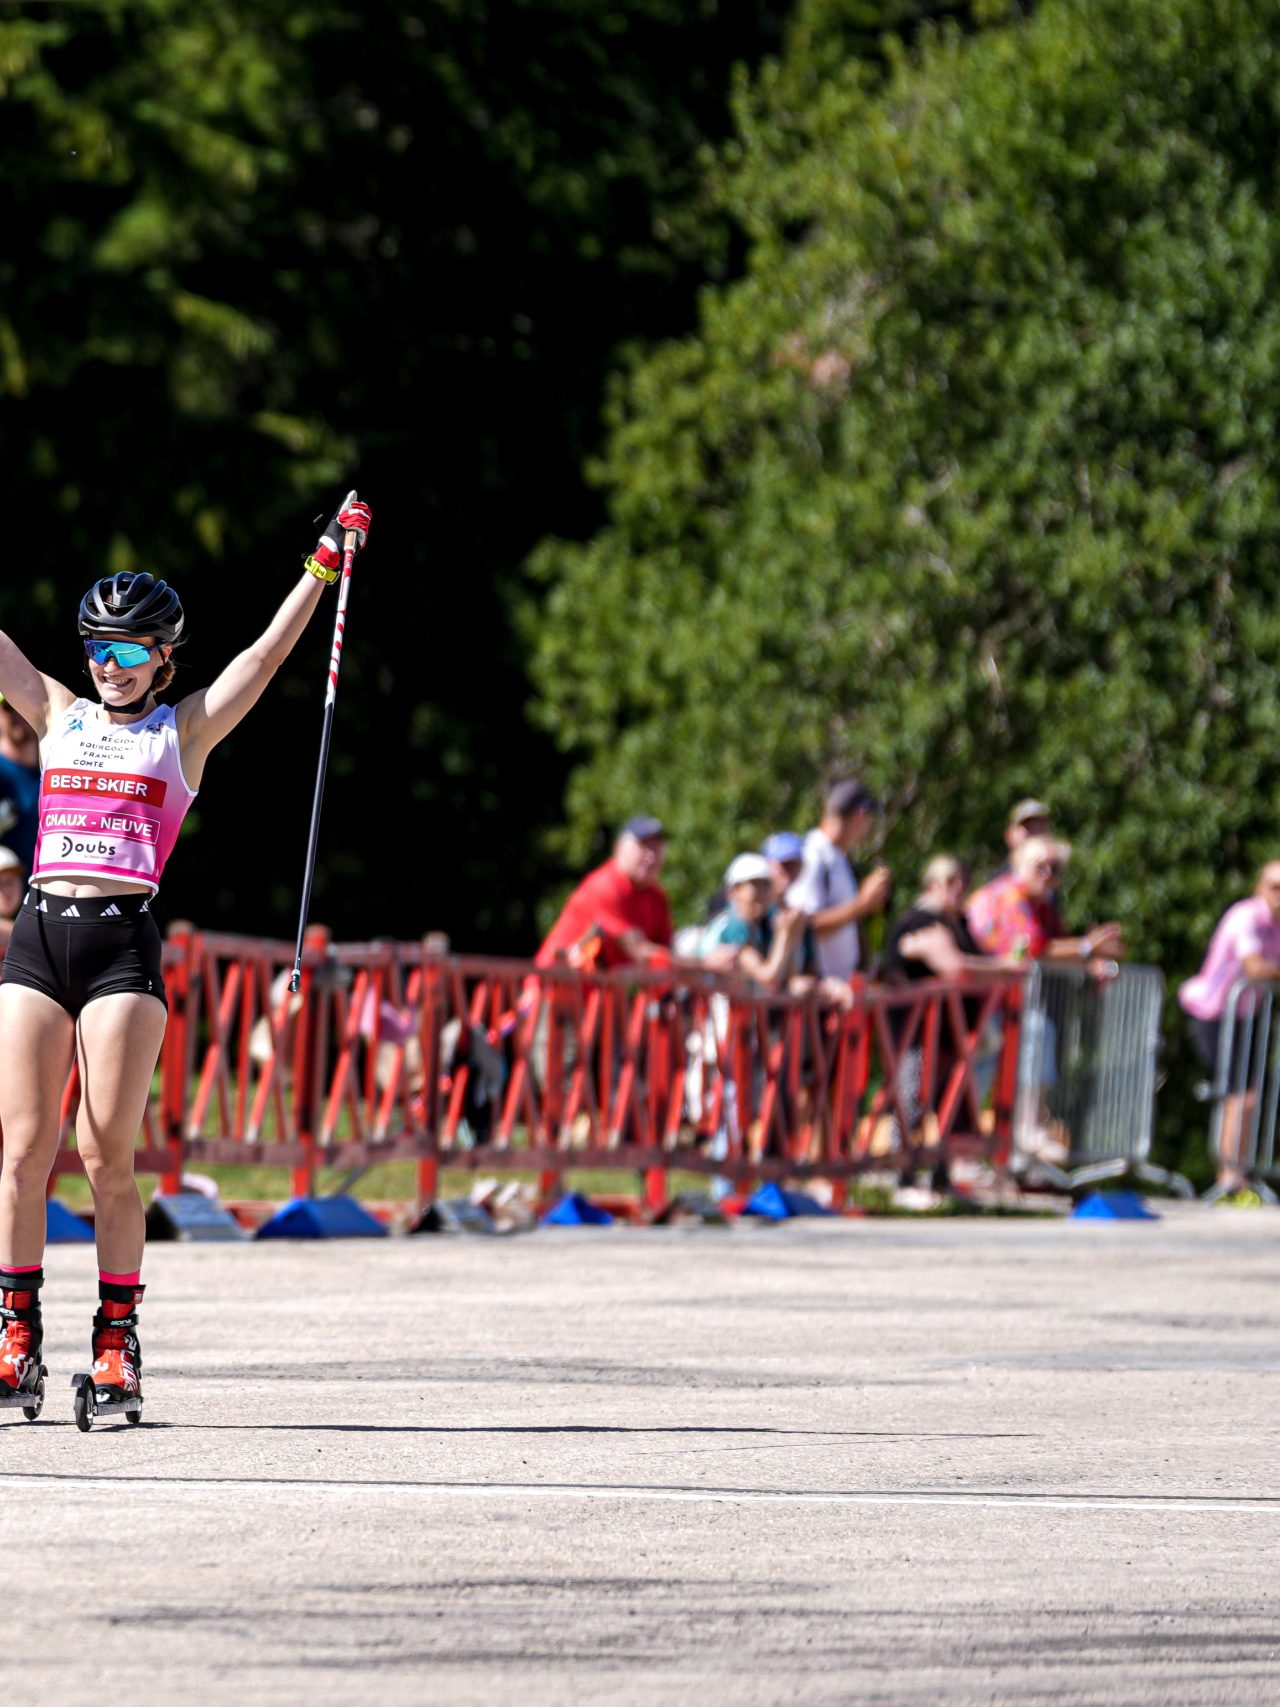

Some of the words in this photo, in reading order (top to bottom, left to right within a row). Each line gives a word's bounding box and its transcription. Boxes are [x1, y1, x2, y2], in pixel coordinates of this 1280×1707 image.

[83, 751, 125, 760] FRANCHE
[50, 775, 92, 790] BEST
[96, 778, 148, 797] SKIER
[45, 813, 88, 828] CHAUX
[100, 817, 153, 837] NEUVE
[61, 835, 116, 858] Doubs
